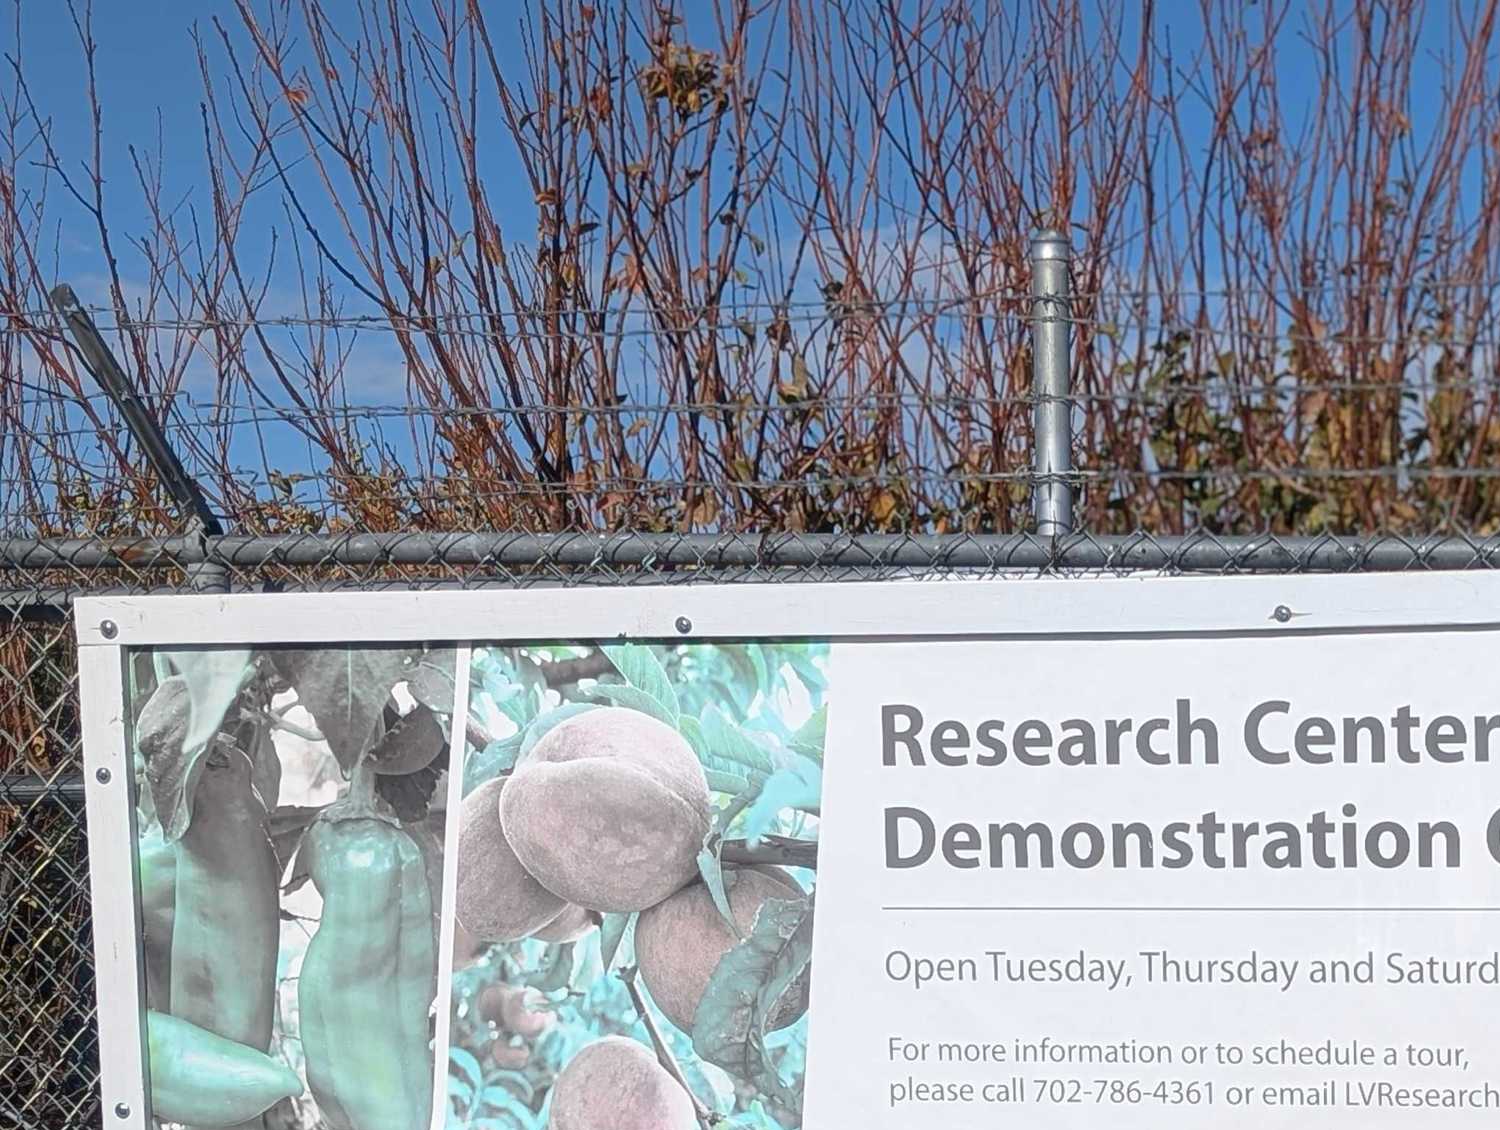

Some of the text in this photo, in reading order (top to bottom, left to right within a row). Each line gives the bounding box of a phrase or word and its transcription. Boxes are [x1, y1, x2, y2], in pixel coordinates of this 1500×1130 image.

[882, 699, 1219, 767] Research
[885, 803, 1460, 869] Demonstration
[886, 951, 976, 989] Open
[985, 950, 1131, 990] Tuesday,
[1140, 951, 1298, 991] Thursday
[1310, 952, 1373, 983] and
[889, 1037, 1468, 1071] For more information or to schedule a tour,
[891, 1076, 973, 1107] please
[982, 1078, 1024, 1103] call
[1034, 1079, 1213, 1105] 702-786-4361
[1226, 1086, 1254, 1106] or
[1263, 1081, 1335, 1106] email
